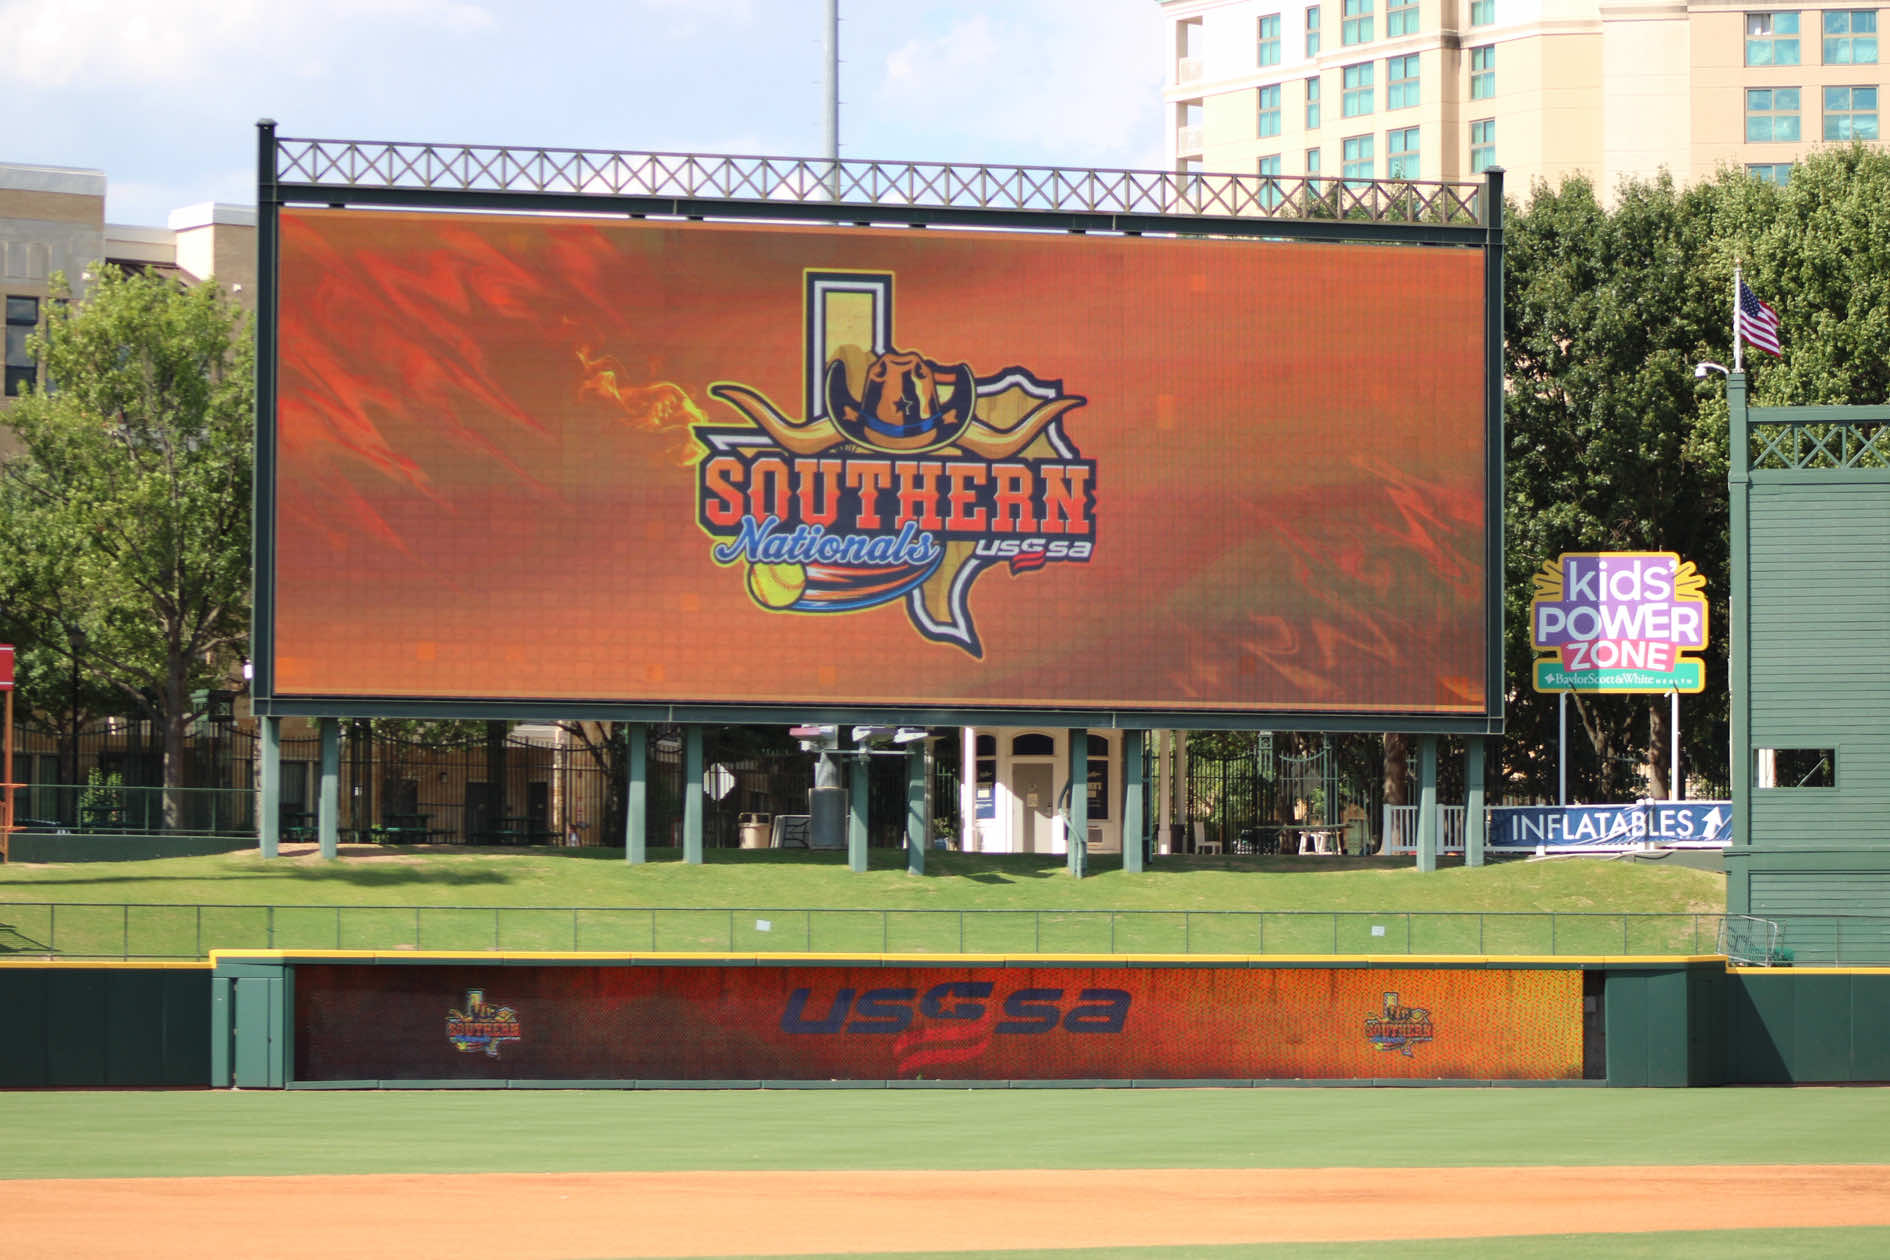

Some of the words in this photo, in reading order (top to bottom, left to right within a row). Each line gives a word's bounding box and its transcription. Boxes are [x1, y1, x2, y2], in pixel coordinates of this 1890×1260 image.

[705, 456, 1090, 533] SOUTHERN
[715, 514, 940, 565] Nationals
[1537, 602, 1699, 643] POWER
[1566, 640, 1669, 671] ZONE
[1511, 809, 1695, 841] INFLATABLES
